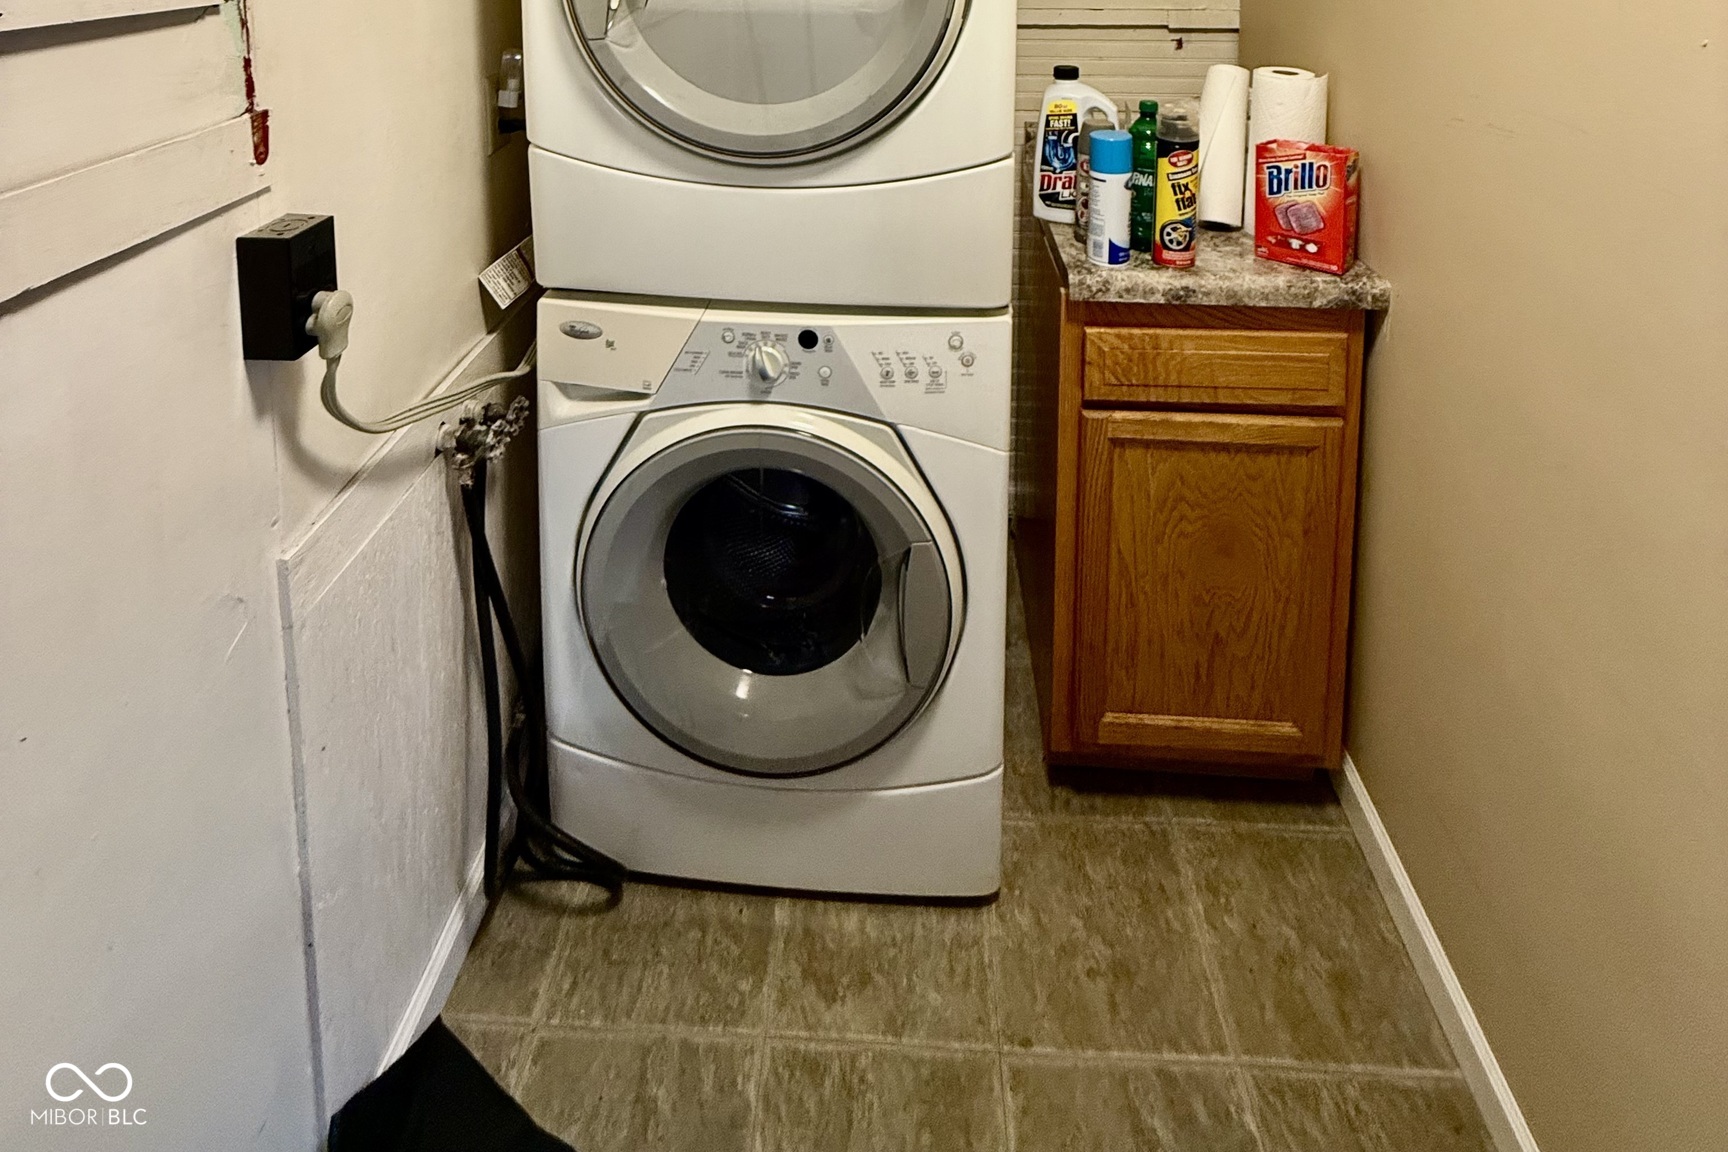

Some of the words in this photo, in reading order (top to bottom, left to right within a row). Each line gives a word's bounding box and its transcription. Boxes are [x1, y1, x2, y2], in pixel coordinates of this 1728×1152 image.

[1050, 119, 1071, 128] FAST!
[1266, 162, 1329, 196] Brillo
[1171, 182, 1190, 196] fix
